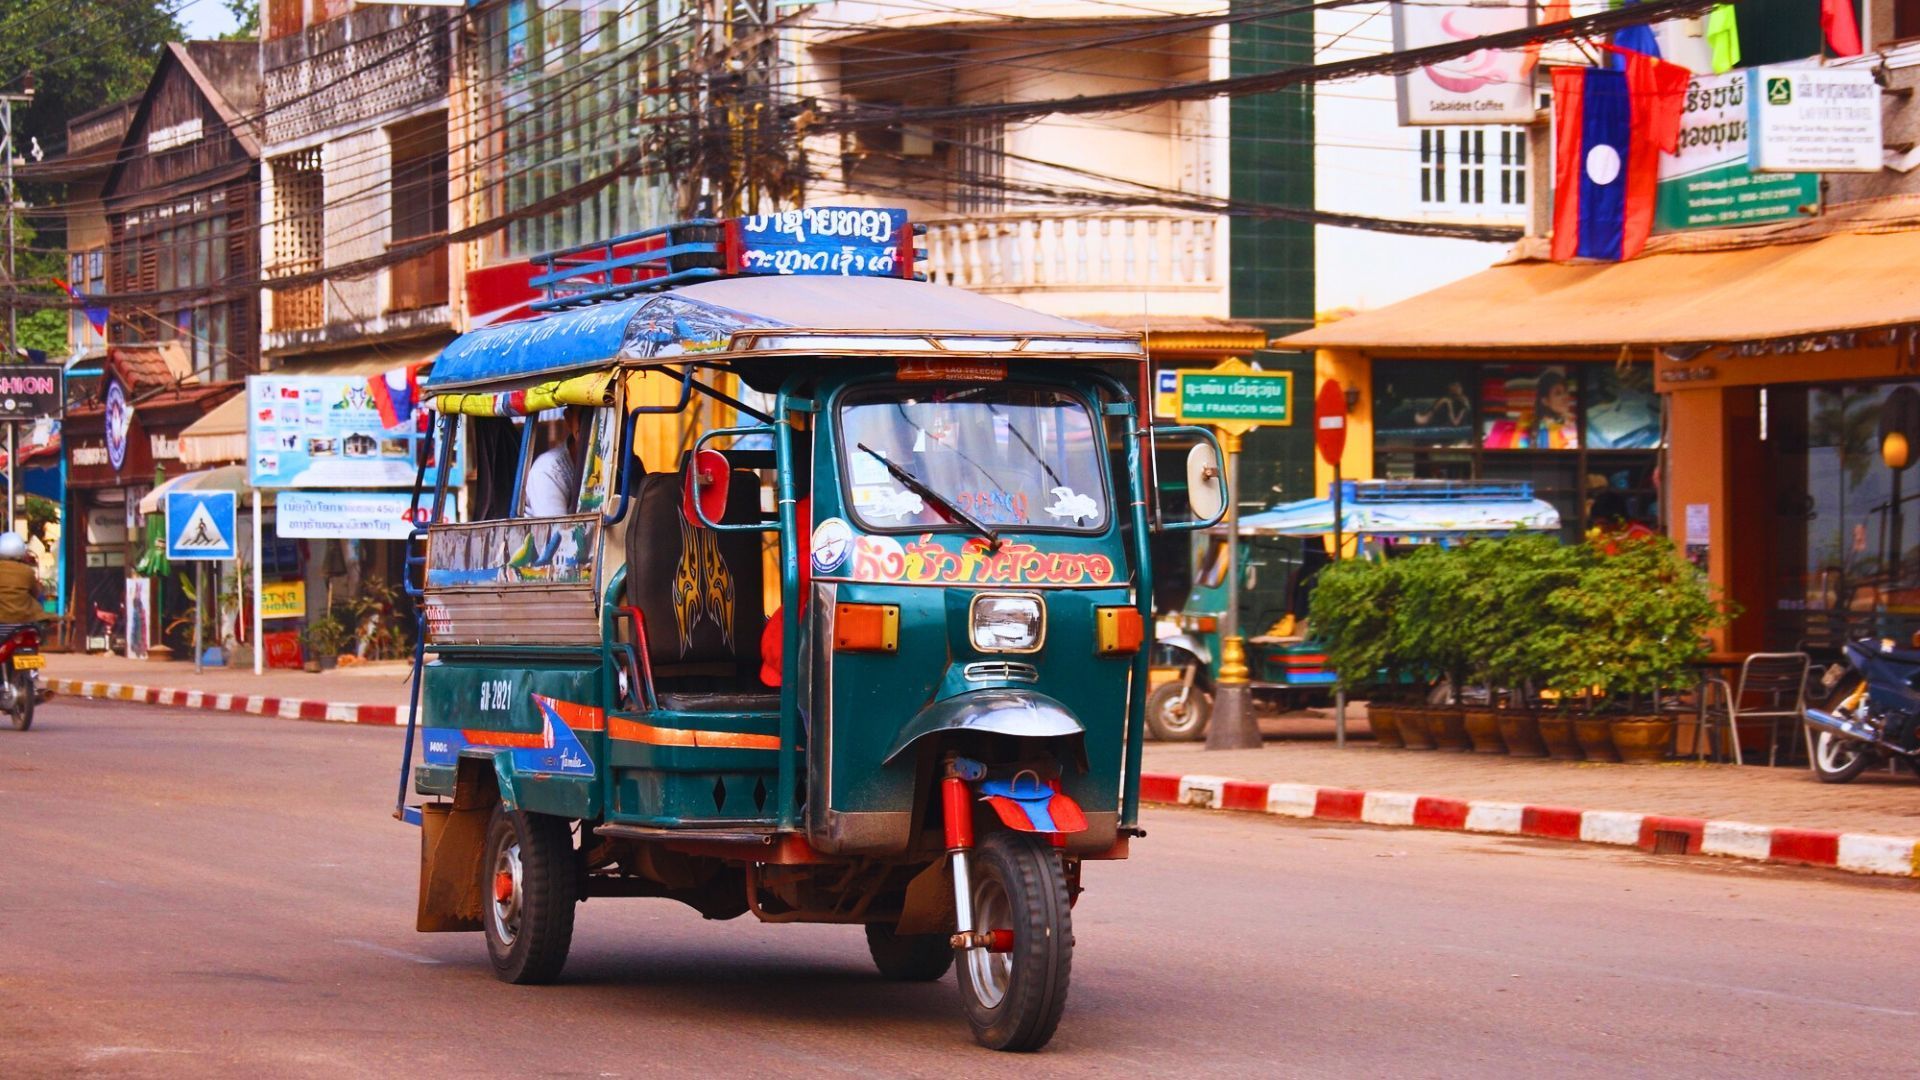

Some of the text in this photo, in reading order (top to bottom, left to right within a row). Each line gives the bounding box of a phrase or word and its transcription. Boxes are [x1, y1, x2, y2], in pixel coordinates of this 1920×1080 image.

[1430, 100, 1504, 111] Sabaidee Coffee
[1183, 403, 1204, 412] RUE
[1206, 404, 1258, 414] FRANÇOIS
[491, 680, 512, 710] 2821
